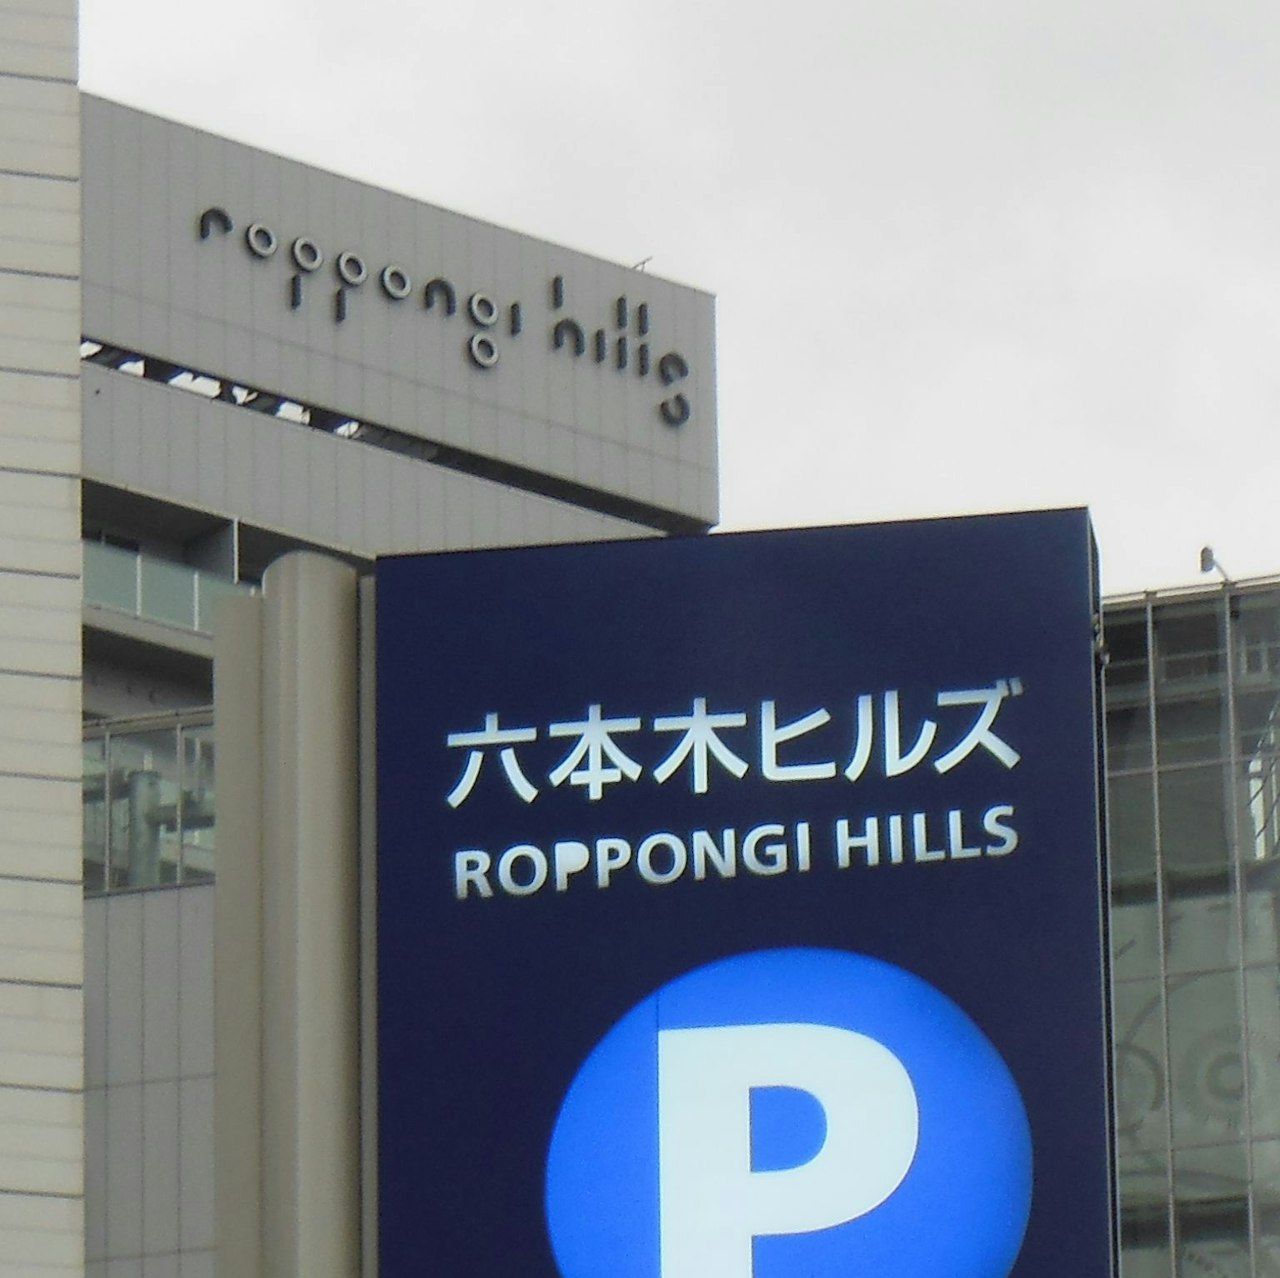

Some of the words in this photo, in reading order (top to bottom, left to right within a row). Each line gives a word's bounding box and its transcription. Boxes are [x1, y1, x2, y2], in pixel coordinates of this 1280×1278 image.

[200, 206, 523, 370] roppongi
[552, 273, 691, 428] hills
[446, 676, 1024, 808] 六本木ヒルズ
[454, 821, 811, 899] ROPPONGI
[836, 804, 1020, 869] HILLS
